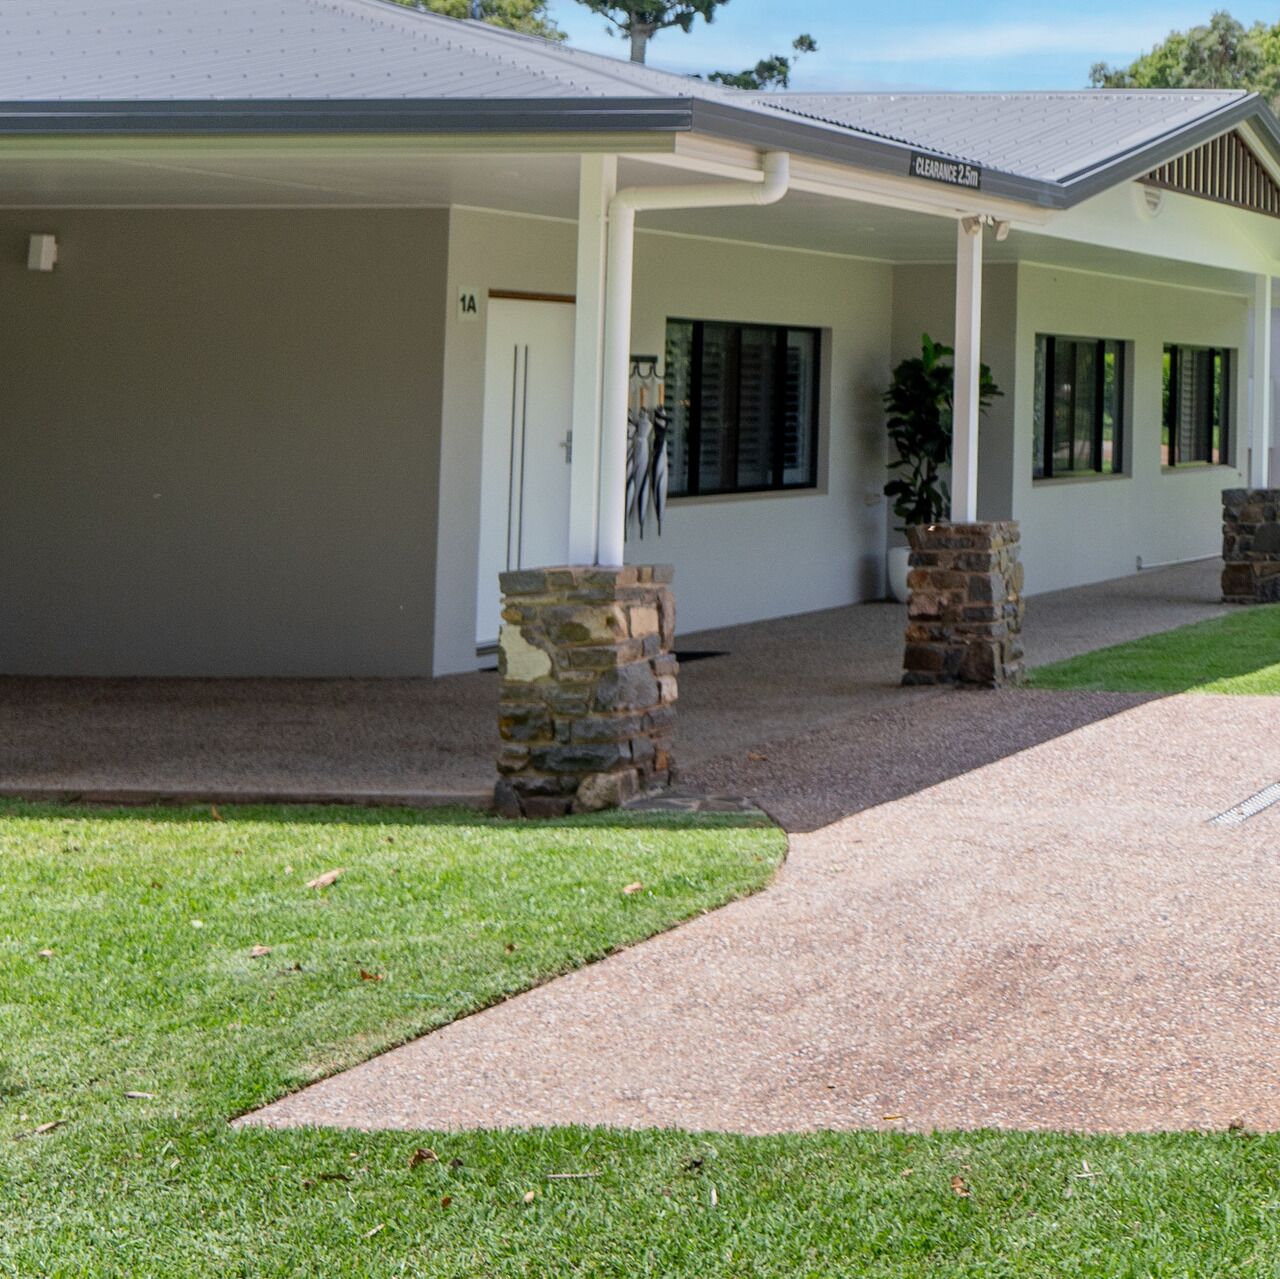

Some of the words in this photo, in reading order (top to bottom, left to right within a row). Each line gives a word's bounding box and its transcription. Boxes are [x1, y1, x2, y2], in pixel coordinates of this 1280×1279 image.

[916, 157, 957, 183] CLEARANCE
[958, 164, 978, 187] 2.5m
[460, 294, 476, 313] 1A
